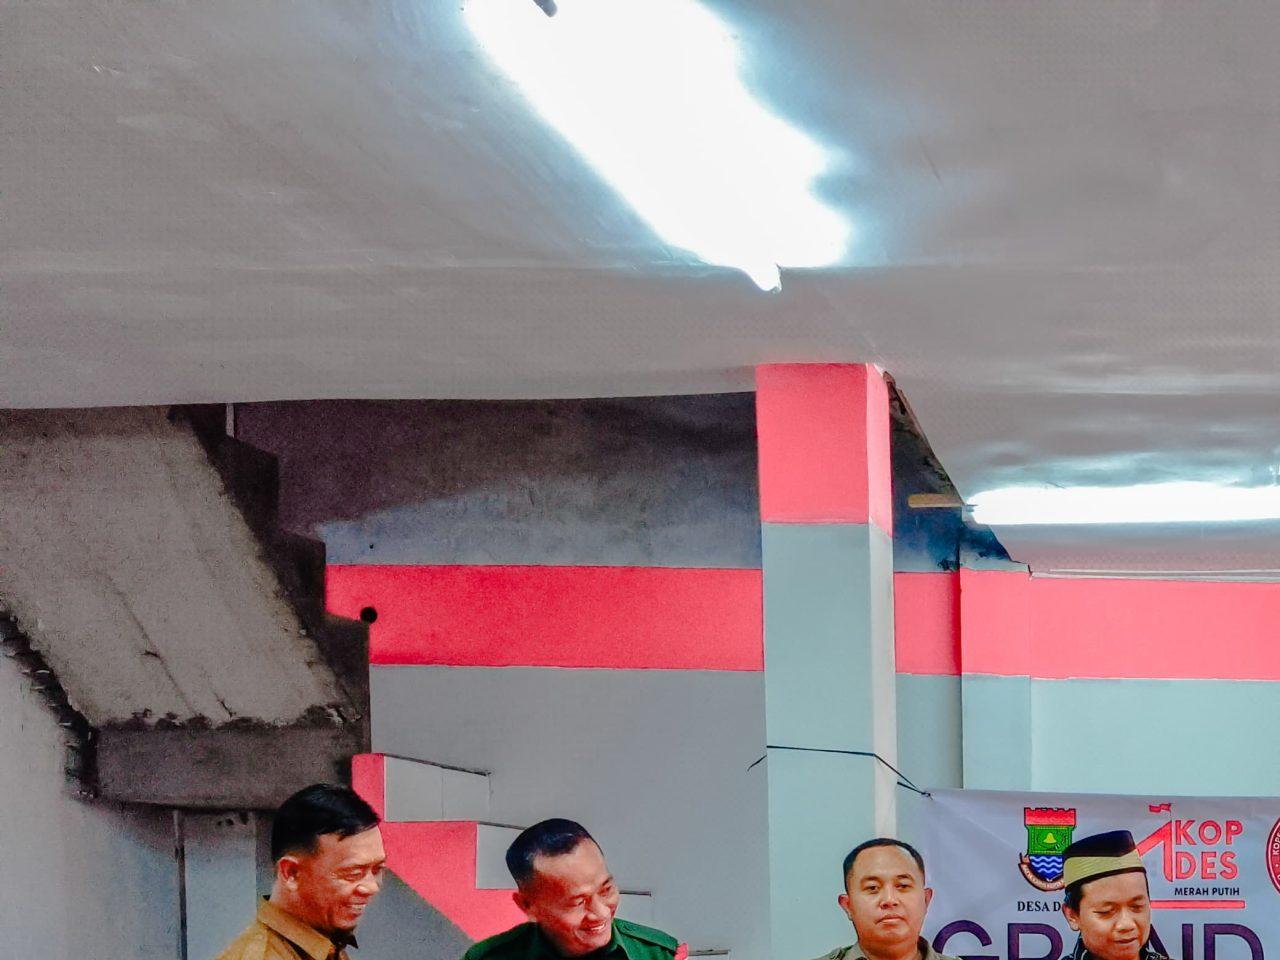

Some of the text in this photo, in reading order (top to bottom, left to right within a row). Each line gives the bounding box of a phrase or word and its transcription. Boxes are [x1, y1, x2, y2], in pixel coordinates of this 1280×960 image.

[1174, 819, 1244, 847] KOP
[1175, 850, 1239, 880] DES
[1174, 886, 1240, 897] MERAH PUTIH
[1016, 900, 1051, 912] DESA
